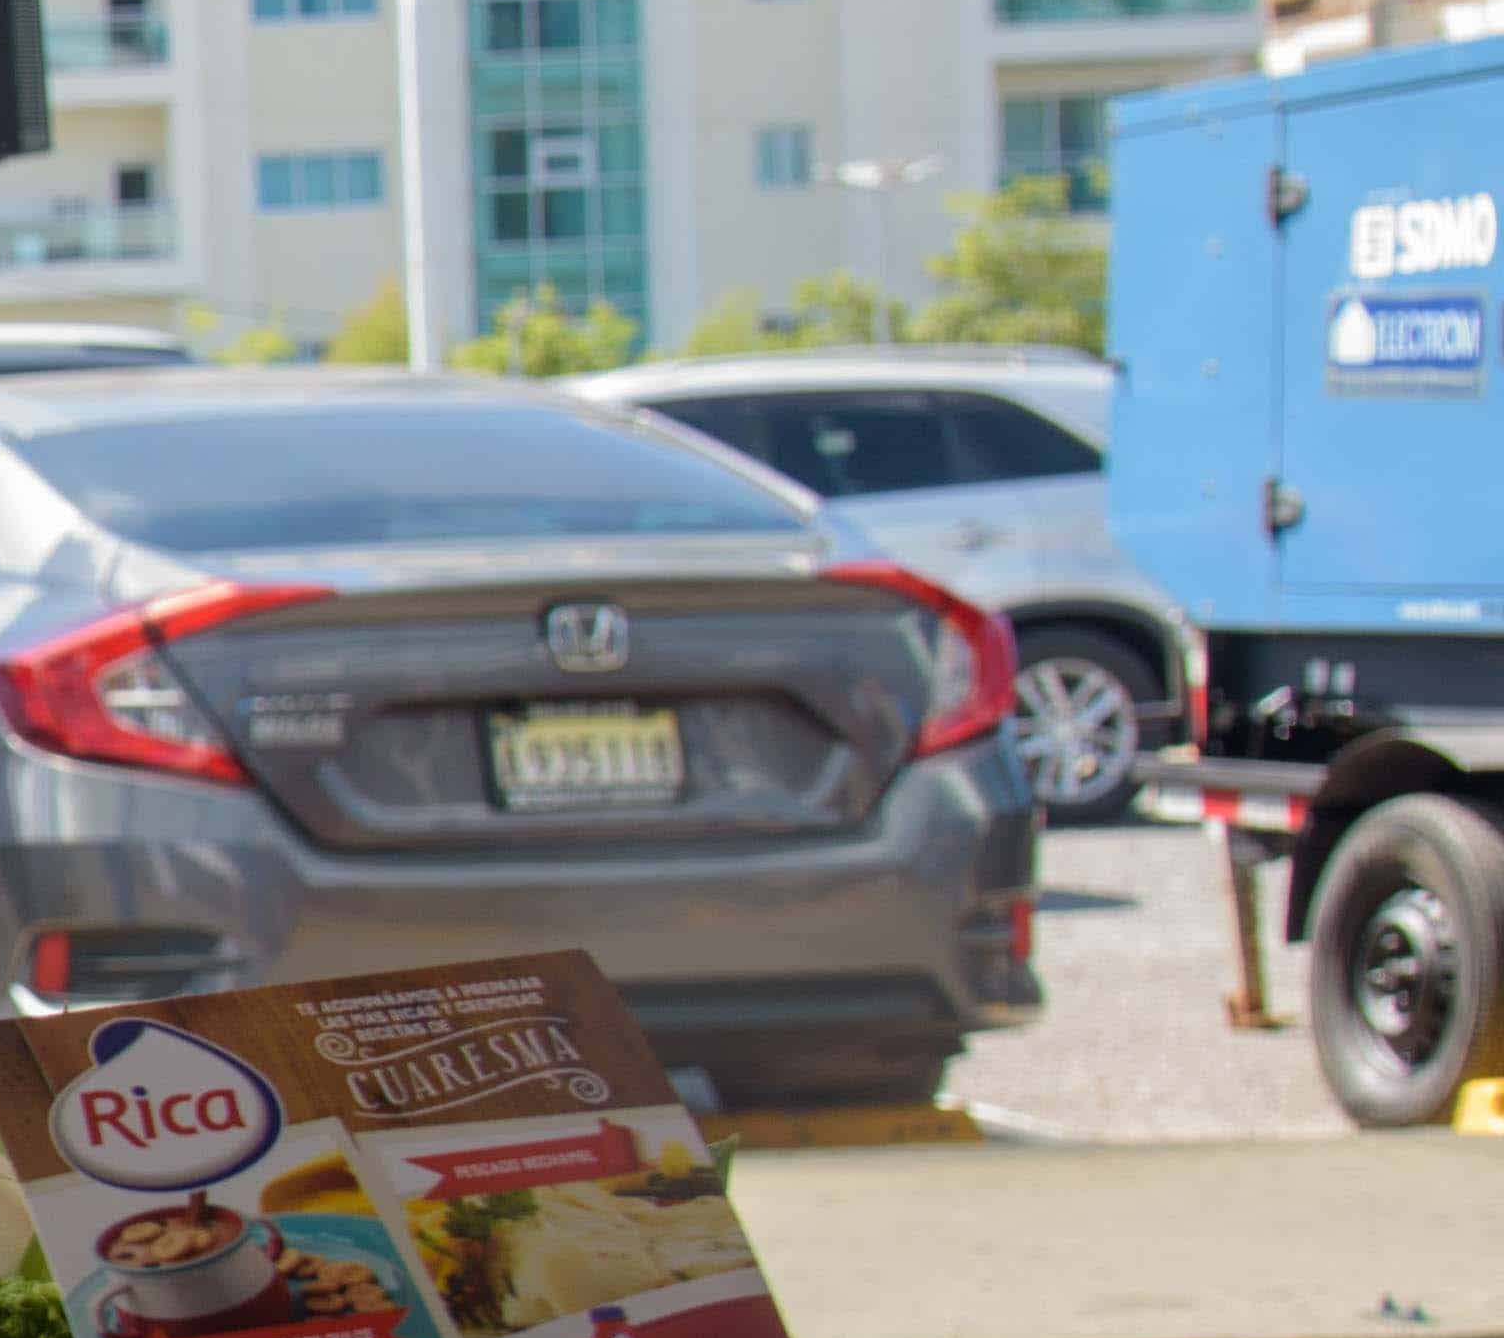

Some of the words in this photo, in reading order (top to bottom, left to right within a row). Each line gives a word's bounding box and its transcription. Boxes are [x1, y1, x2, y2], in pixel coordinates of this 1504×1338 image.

[1395, 193, 1497, 274] SDMO
[346, 1025, 581, 1110] CUARESMA
[80, 1085, 246, 1149] Rica
